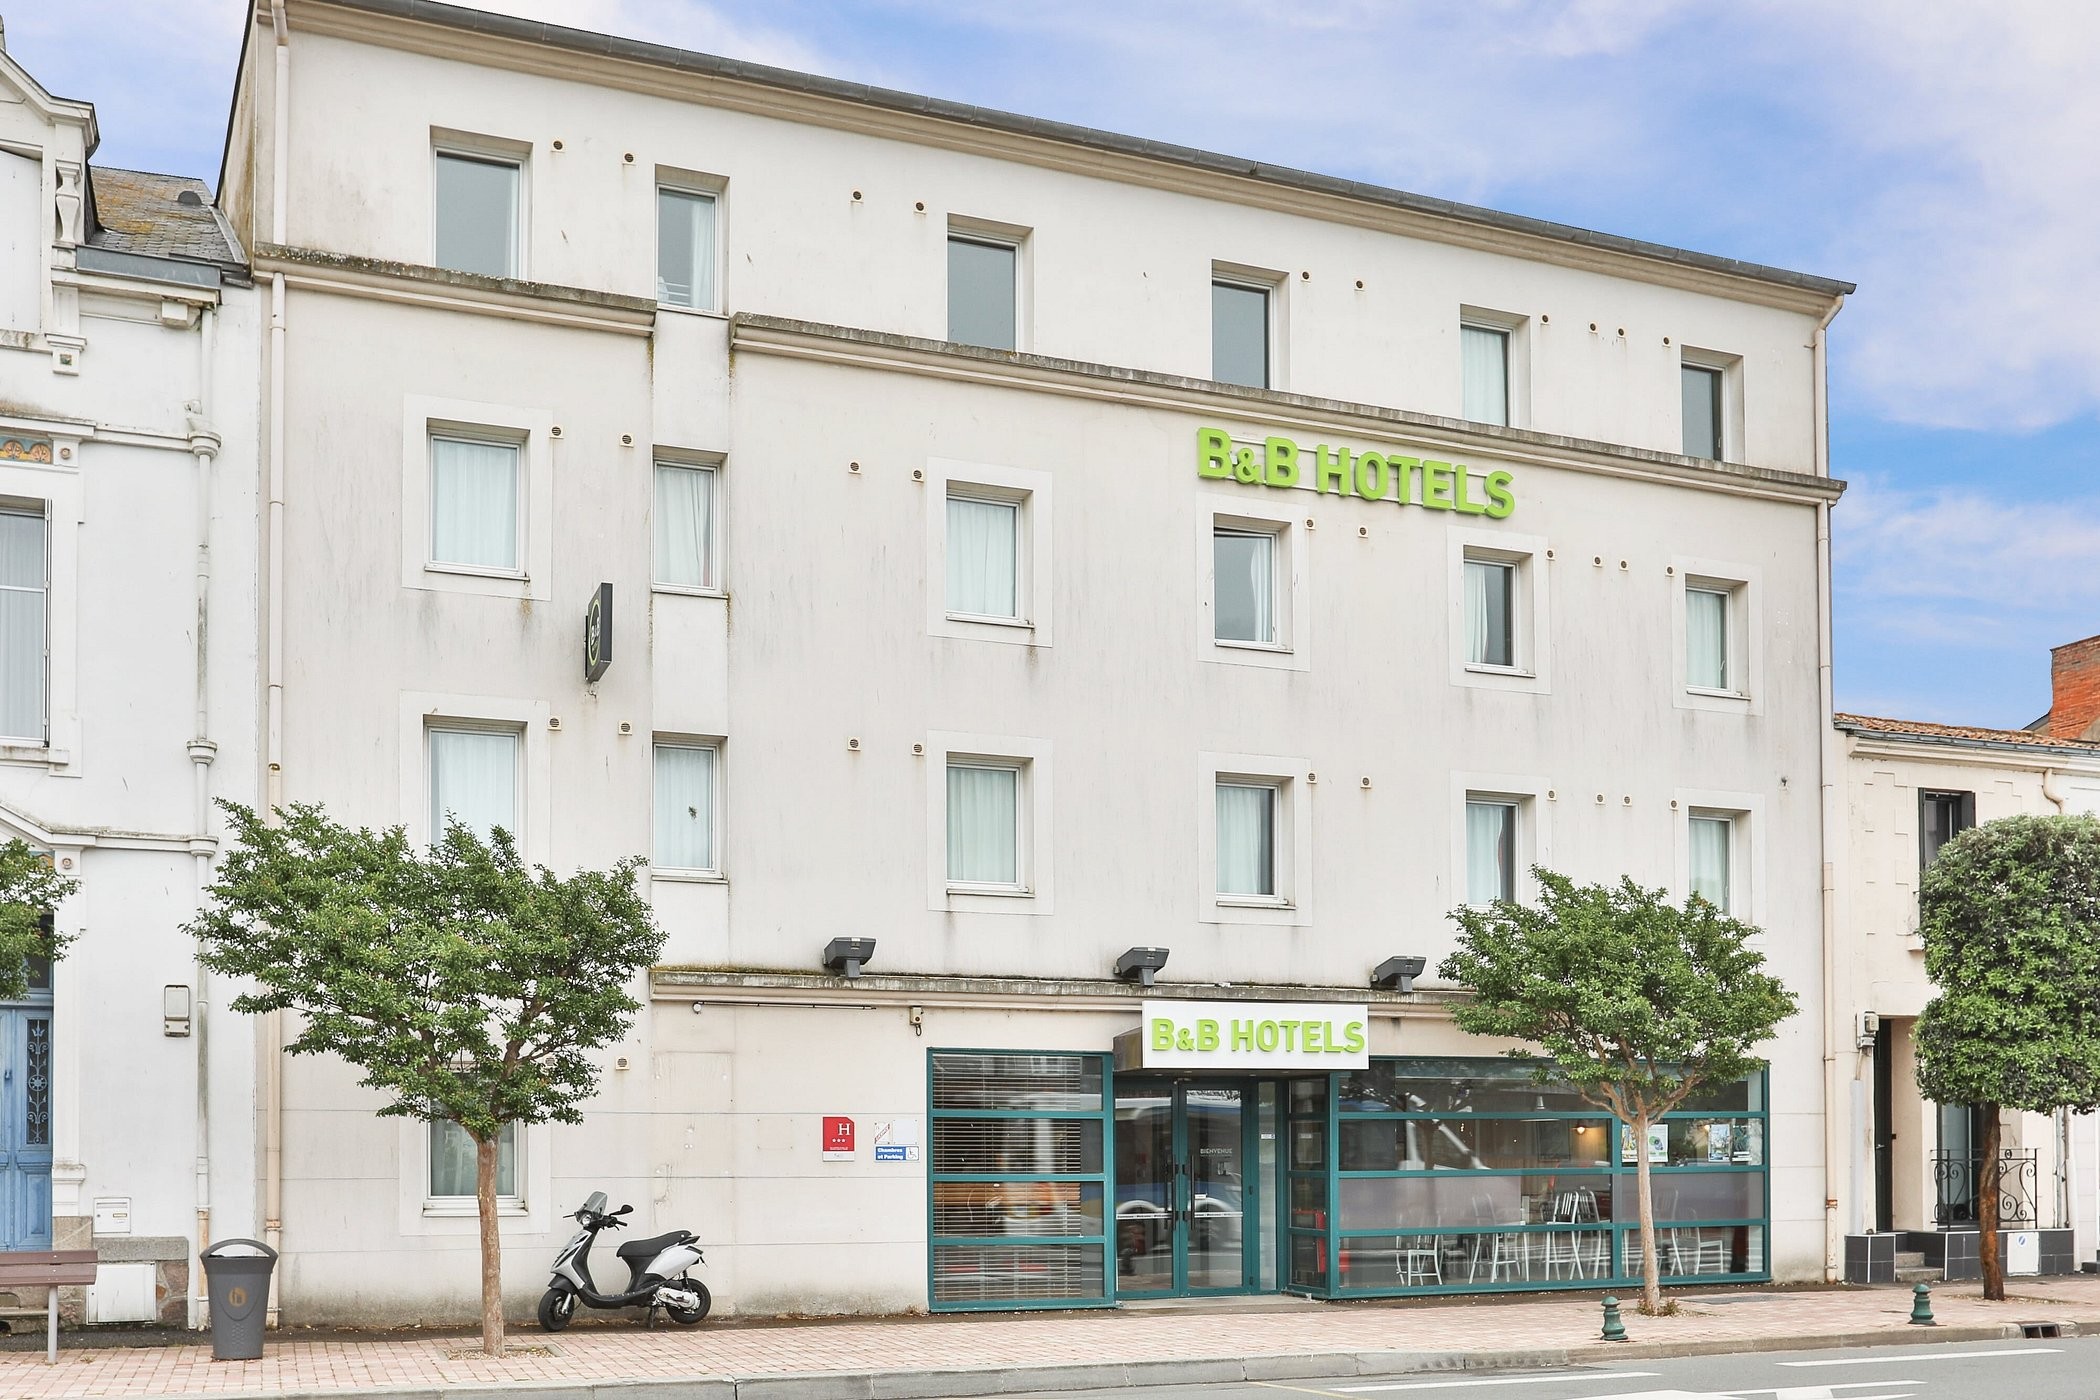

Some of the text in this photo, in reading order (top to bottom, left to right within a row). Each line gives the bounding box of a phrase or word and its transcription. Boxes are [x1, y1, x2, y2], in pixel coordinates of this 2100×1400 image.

[1197, 427, 1515, 519] B&B HOTELS
[1151, 1018, 1365, 1053] B&B HOTELS
[838, 1123, 850, 1136] H
